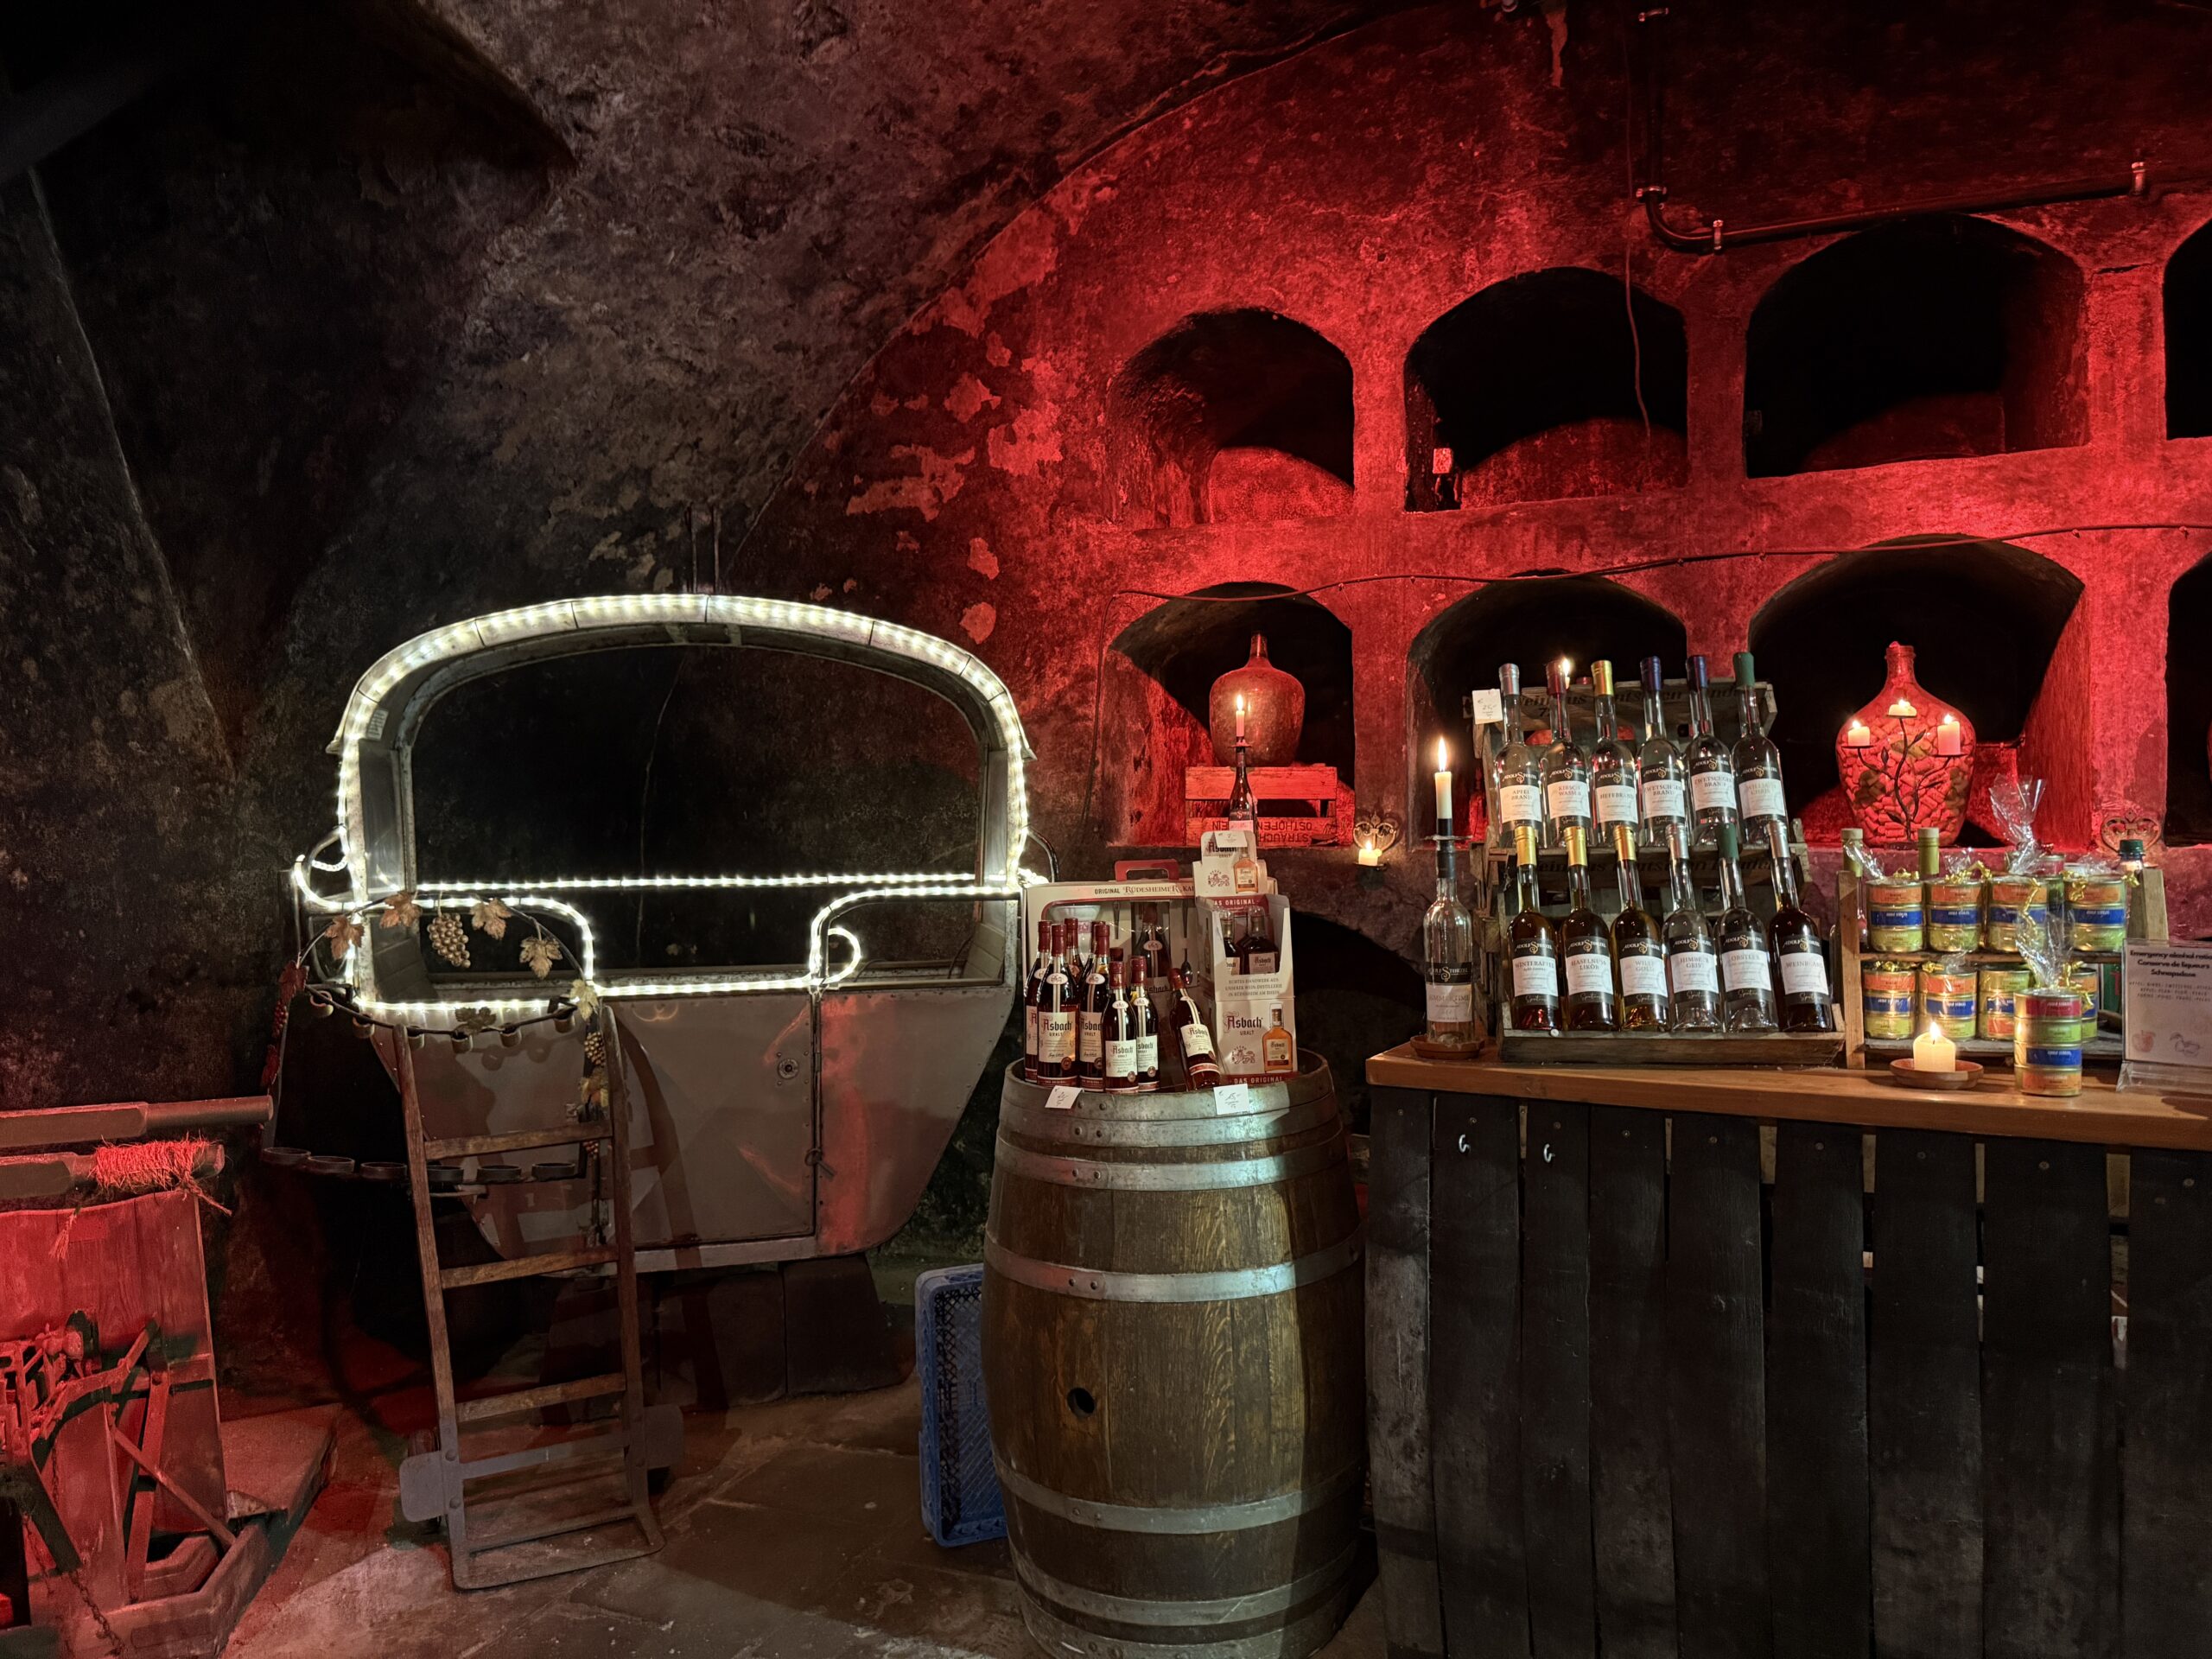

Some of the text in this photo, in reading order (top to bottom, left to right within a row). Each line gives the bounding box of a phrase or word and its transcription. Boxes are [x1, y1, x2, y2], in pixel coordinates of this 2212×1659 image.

[1258, 821, 1313, 831] OSTHOFEN
[1259, 833, 1309, 843] STRAUCH
[2130, 950, 2169, 960] Emergency
[2181, 961, 2210, 971] liqueurs
[2150, 969, 2196, 978] Schnapsdose
[1042, 1019, 1073, 1033] Asbach
[1225, 1016, 1263, 1030] Asbach
[1250, 1076, 1283, 1084] ORIGINAL
